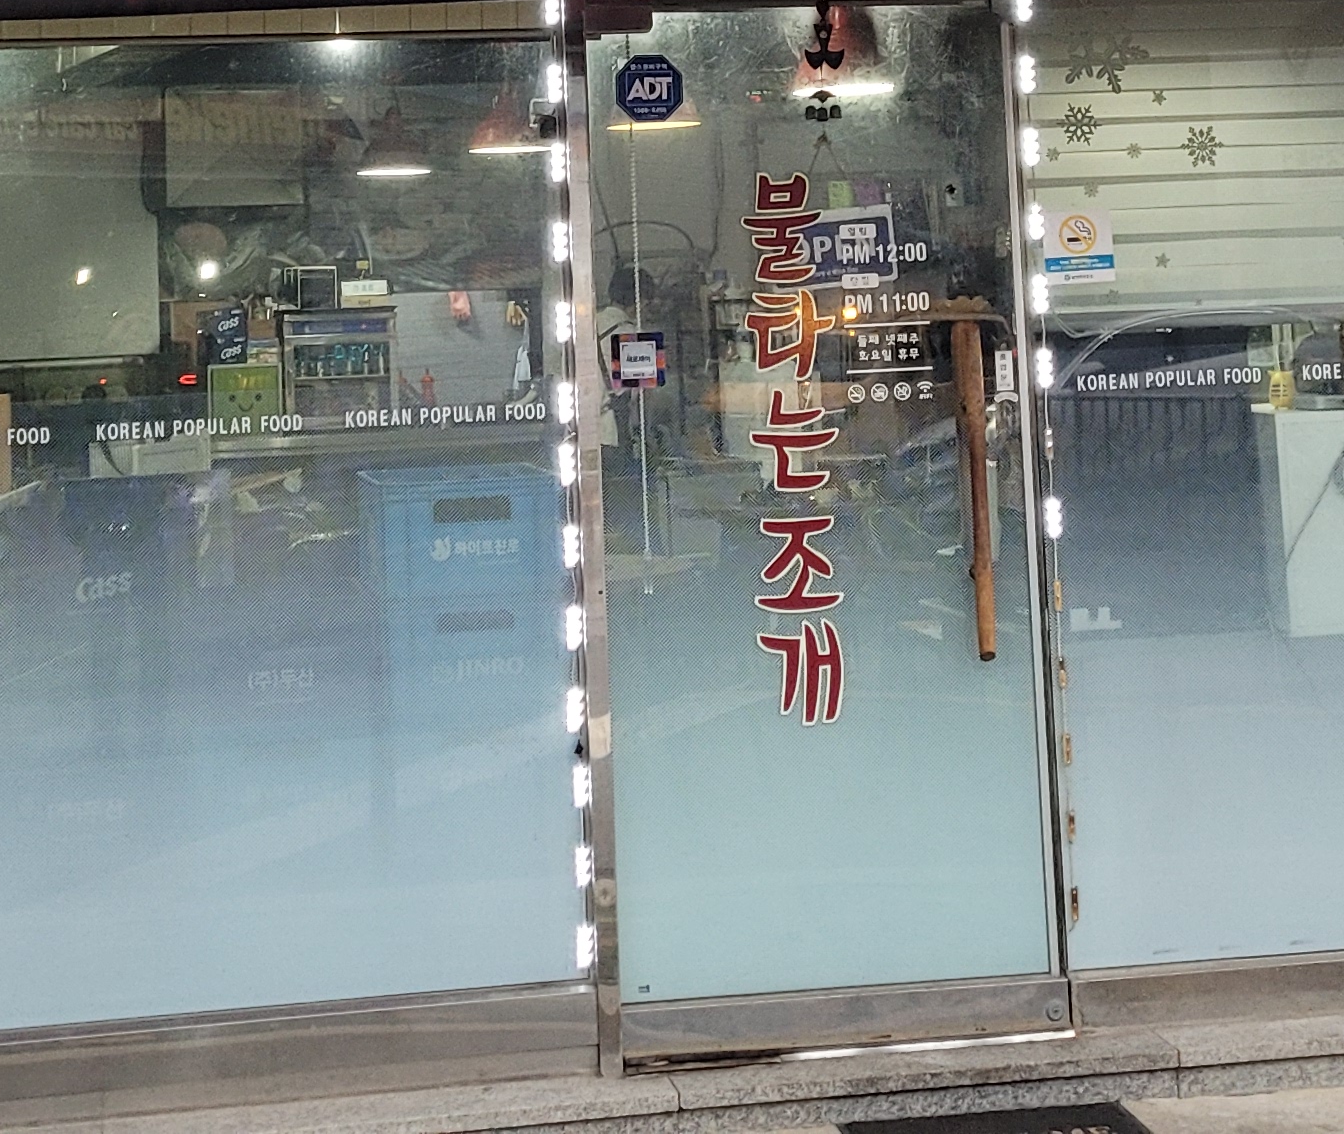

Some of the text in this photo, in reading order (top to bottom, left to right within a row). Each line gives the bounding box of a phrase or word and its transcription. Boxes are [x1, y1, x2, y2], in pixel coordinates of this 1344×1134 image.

[627, 77, 673, 101] ADT
[843, 242, 927, 265] PM 12:00
[844, 292, 930, 314] PM 11:00
[741, 172, 839, 492] 불타는
[1077, 368, 1262, 392] KOREAN POPULAR FOOD
[95, 414, 303, 442] KOREAN POPULAR FOOD
[345, 403, 546, 429] KOREAN POPULAR FOOD
[7, 427, 51, 445] FOOD
[755, 516, 844, 726] 조개
